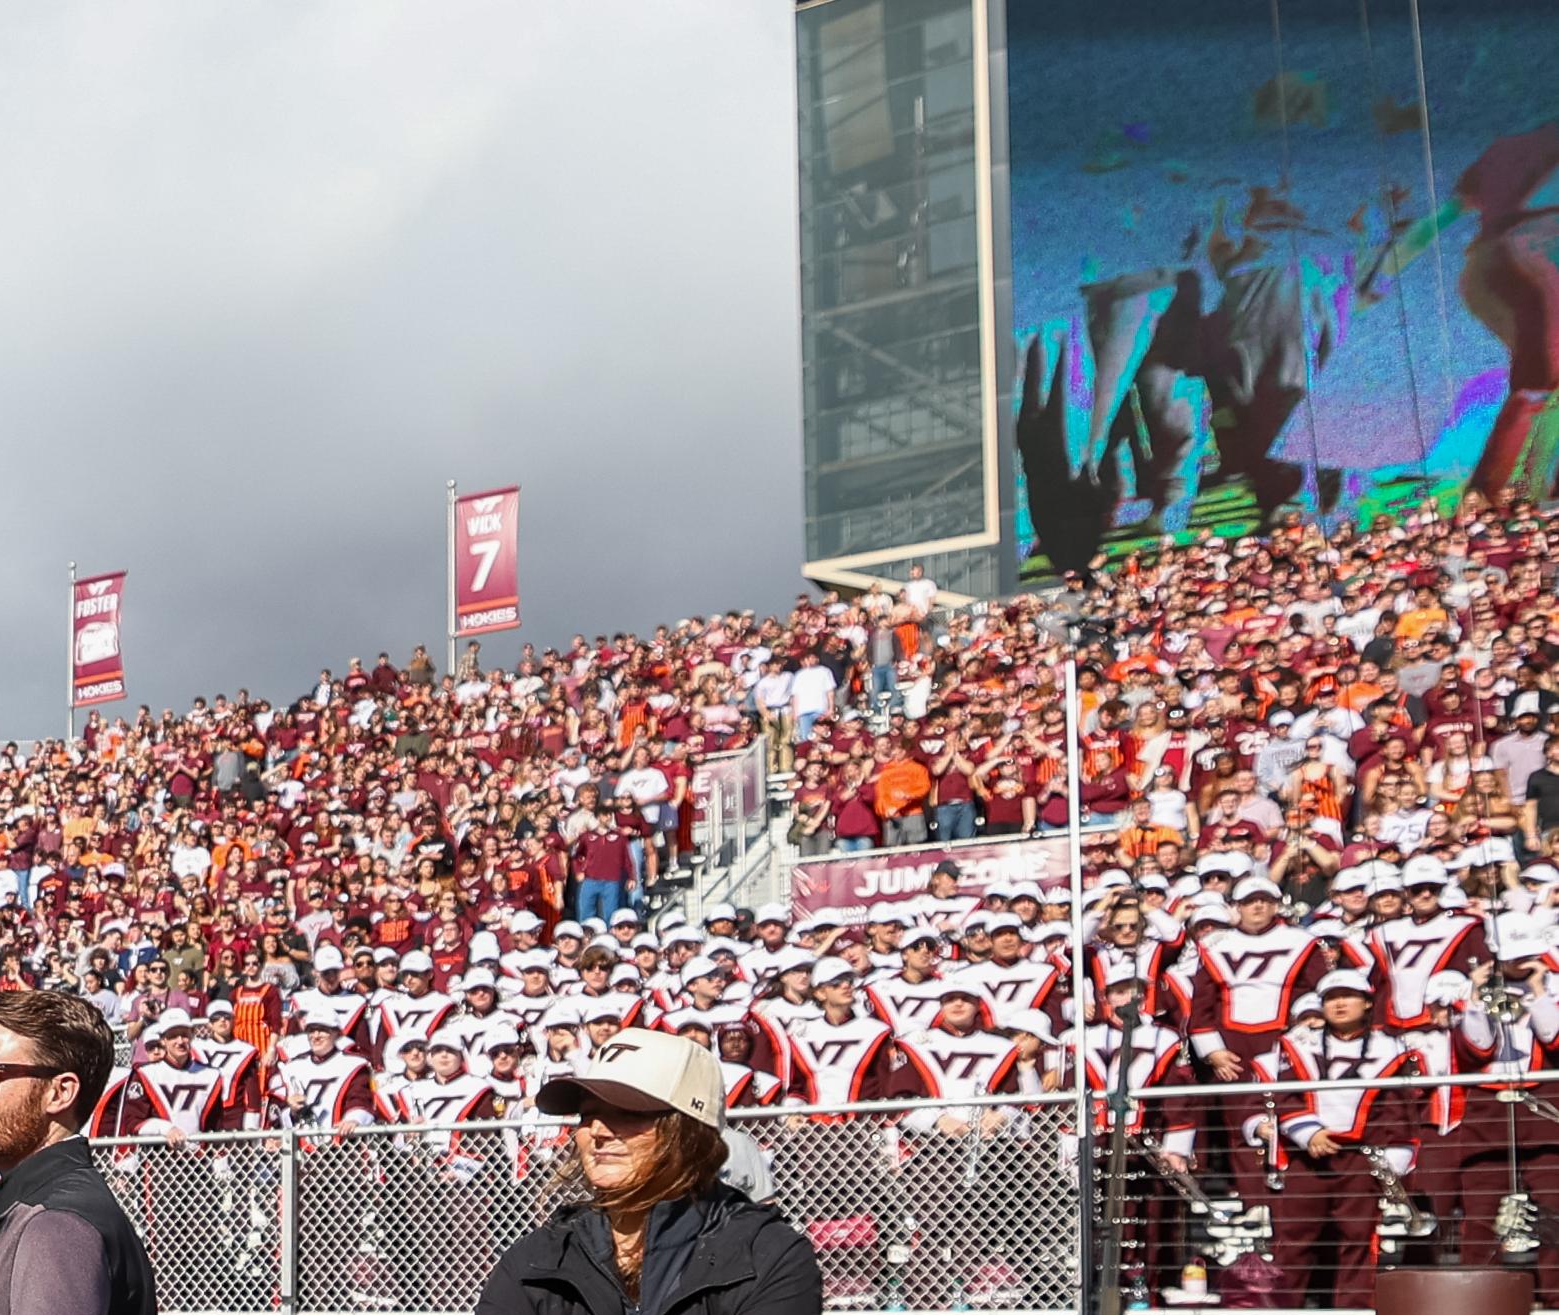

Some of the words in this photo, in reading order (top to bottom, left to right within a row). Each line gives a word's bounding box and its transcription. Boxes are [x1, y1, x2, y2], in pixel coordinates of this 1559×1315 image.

[466, 512, 502, 537] VICK
[469, 539, 501, 593] 7
[76, 592, 118, 619] FOSTER
[460, 606, 517, 630] HOKIES
[77, 679, 123, 700] HOKIES
[1235, 730, 1270, 755] 25
[854, 862, 939, 897] JUM
[1222, 949, 1290, 980] VT
[1385, 938, 1442, 969] VT
[983, 979, 1035, 1001] VT
[393, 1008, 437, 1029] VT
[598, 1042, 642, 1063] VT
[808, 1039, 861, 1066] VT
[933, 1052, 995, 1079] VT
[160, 1082, 209, 1112] VT
